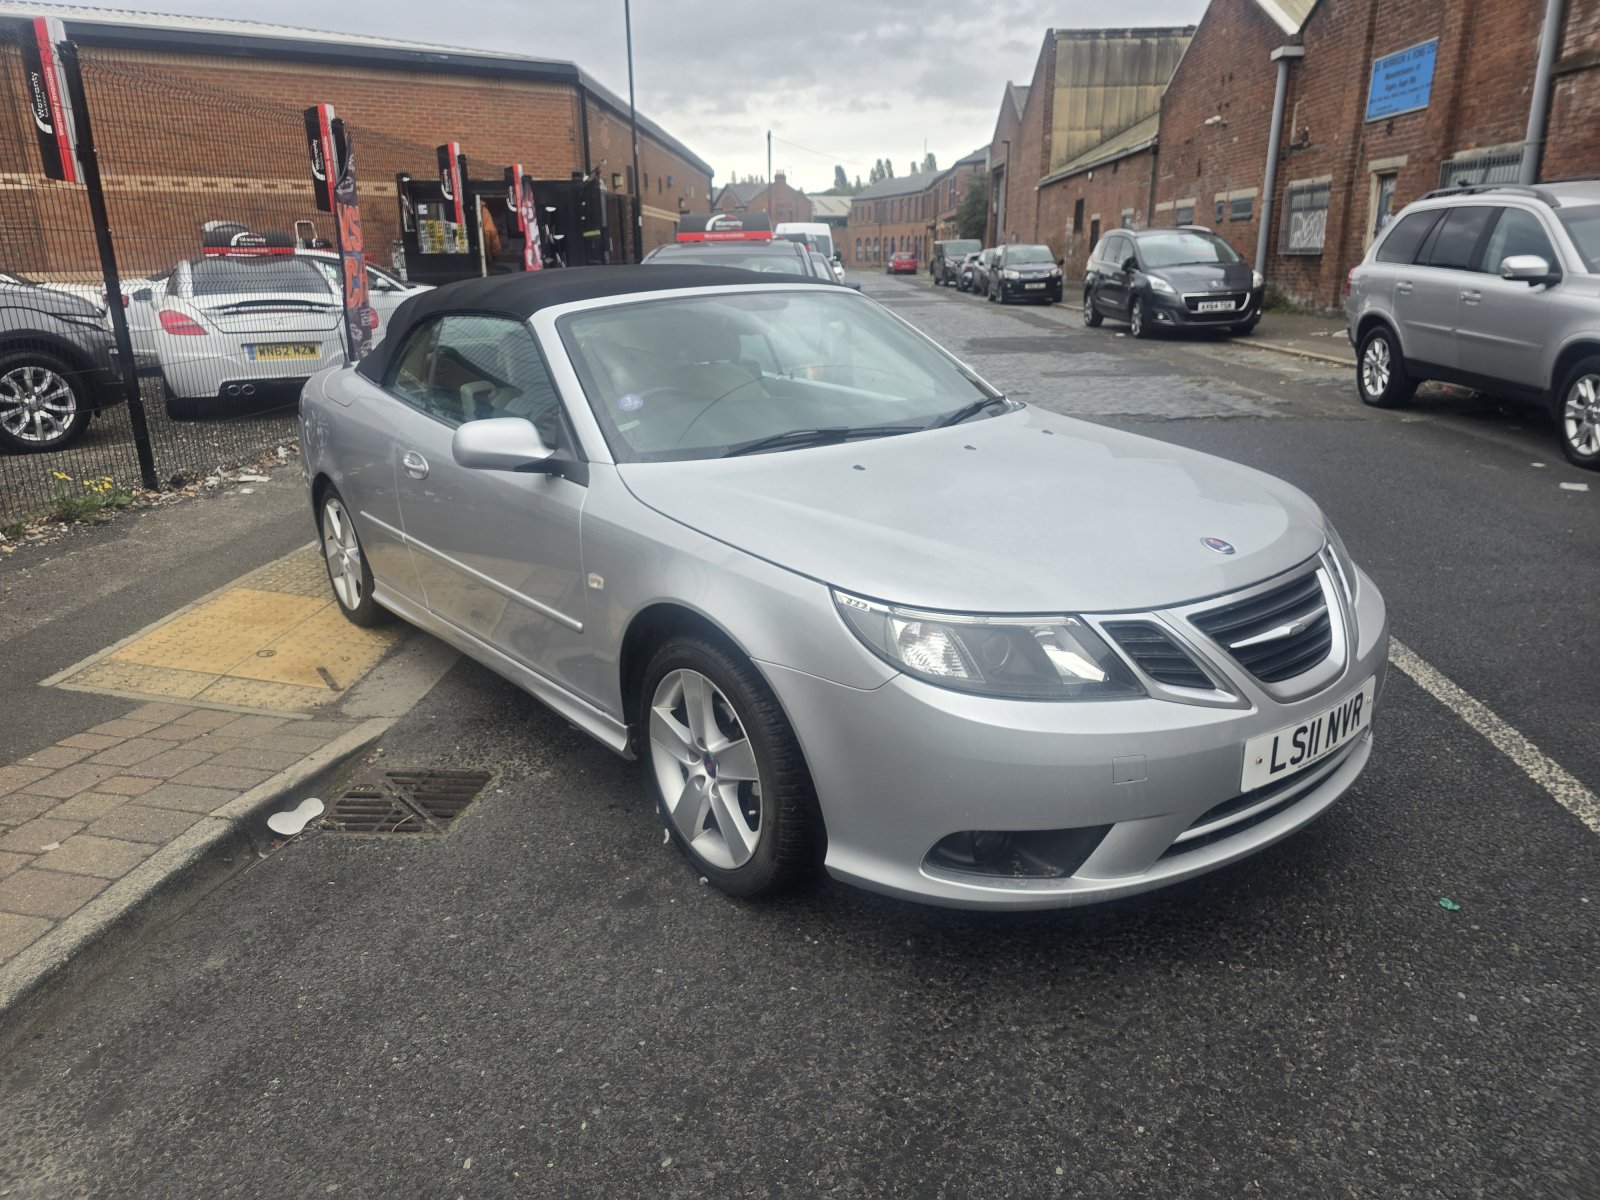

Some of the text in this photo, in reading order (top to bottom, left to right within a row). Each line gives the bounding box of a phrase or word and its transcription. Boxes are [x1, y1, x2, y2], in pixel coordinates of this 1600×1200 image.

[31, 72, 44, 118] Warranty
[47, 66, 57, 100] available
[1269, 717, 1322, 775] LS11
[1325, 691, 1364, 749] NVR
